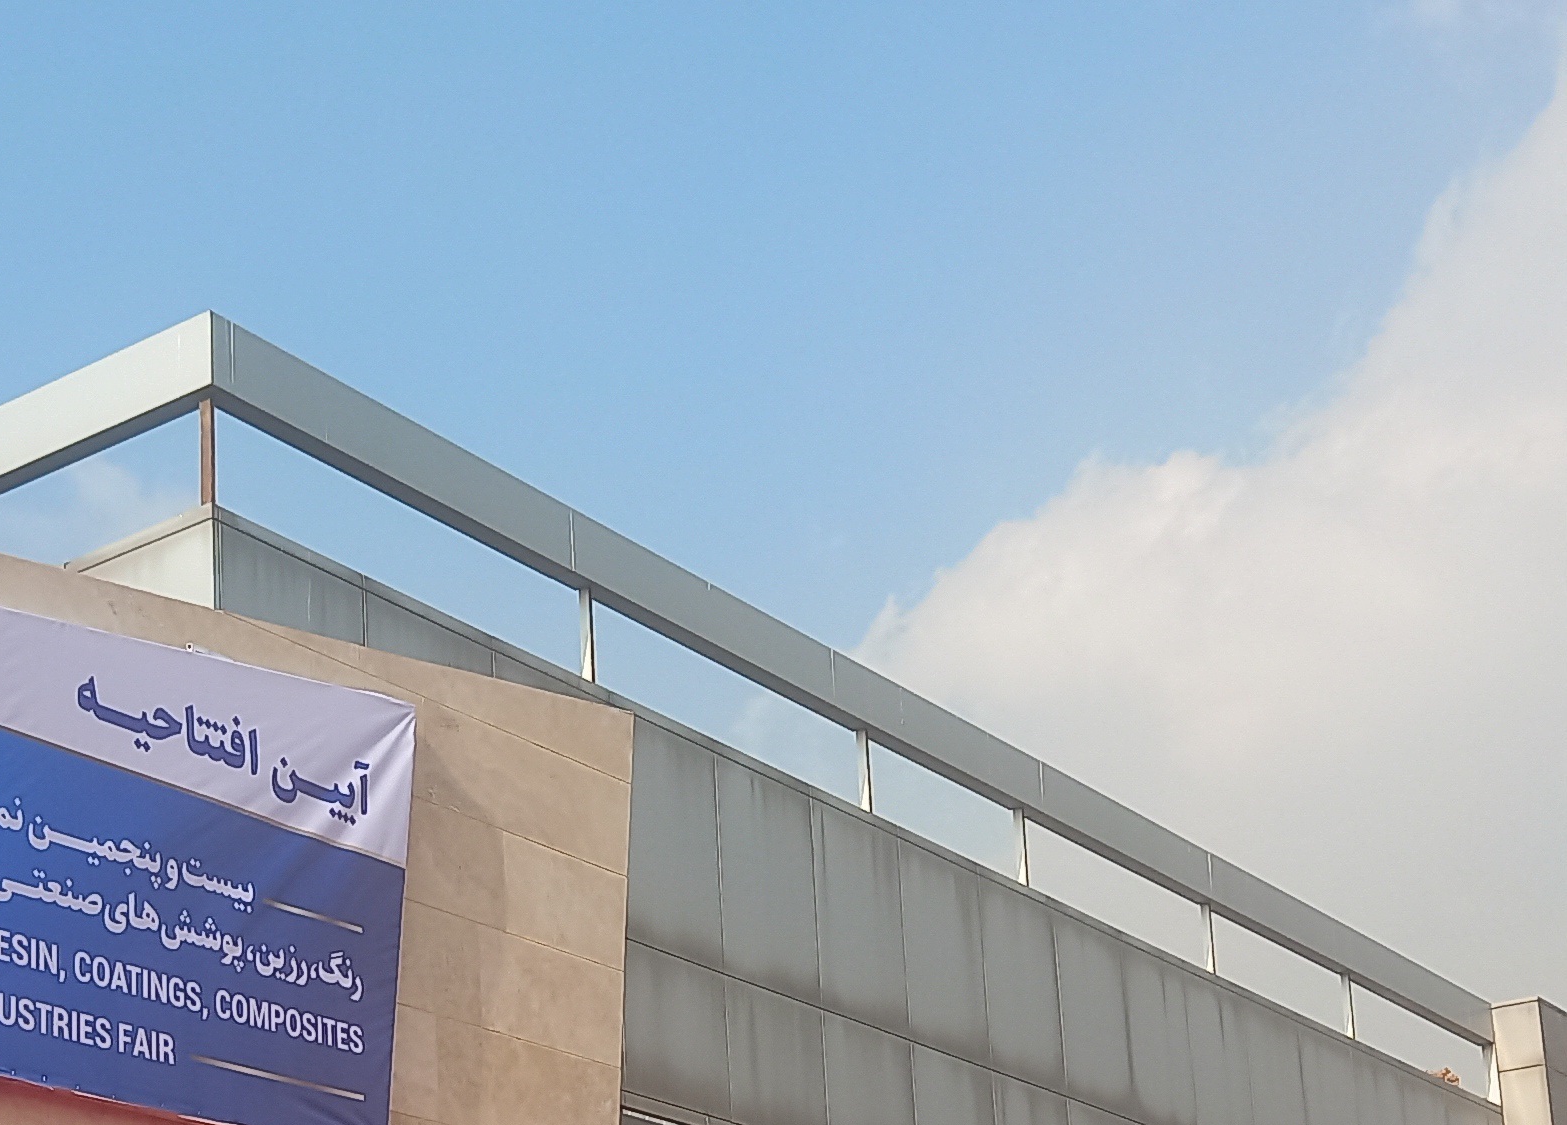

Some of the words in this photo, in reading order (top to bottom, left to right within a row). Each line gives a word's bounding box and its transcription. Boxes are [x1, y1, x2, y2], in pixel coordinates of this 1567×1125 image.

[75, 675, 259, 777] افتتاحیه
[272, 757, 370, 825] آیین
[28, 816, 162, 889] پنجمین
[164, 858, 179, 890] و
[182, 857, 254, 913] بیست
[73, 951, 209, 1021] COATINGS,
[215, 988, 364, 1054] COMPOSITES
[118, 1022, 177, 1065] FAIR
